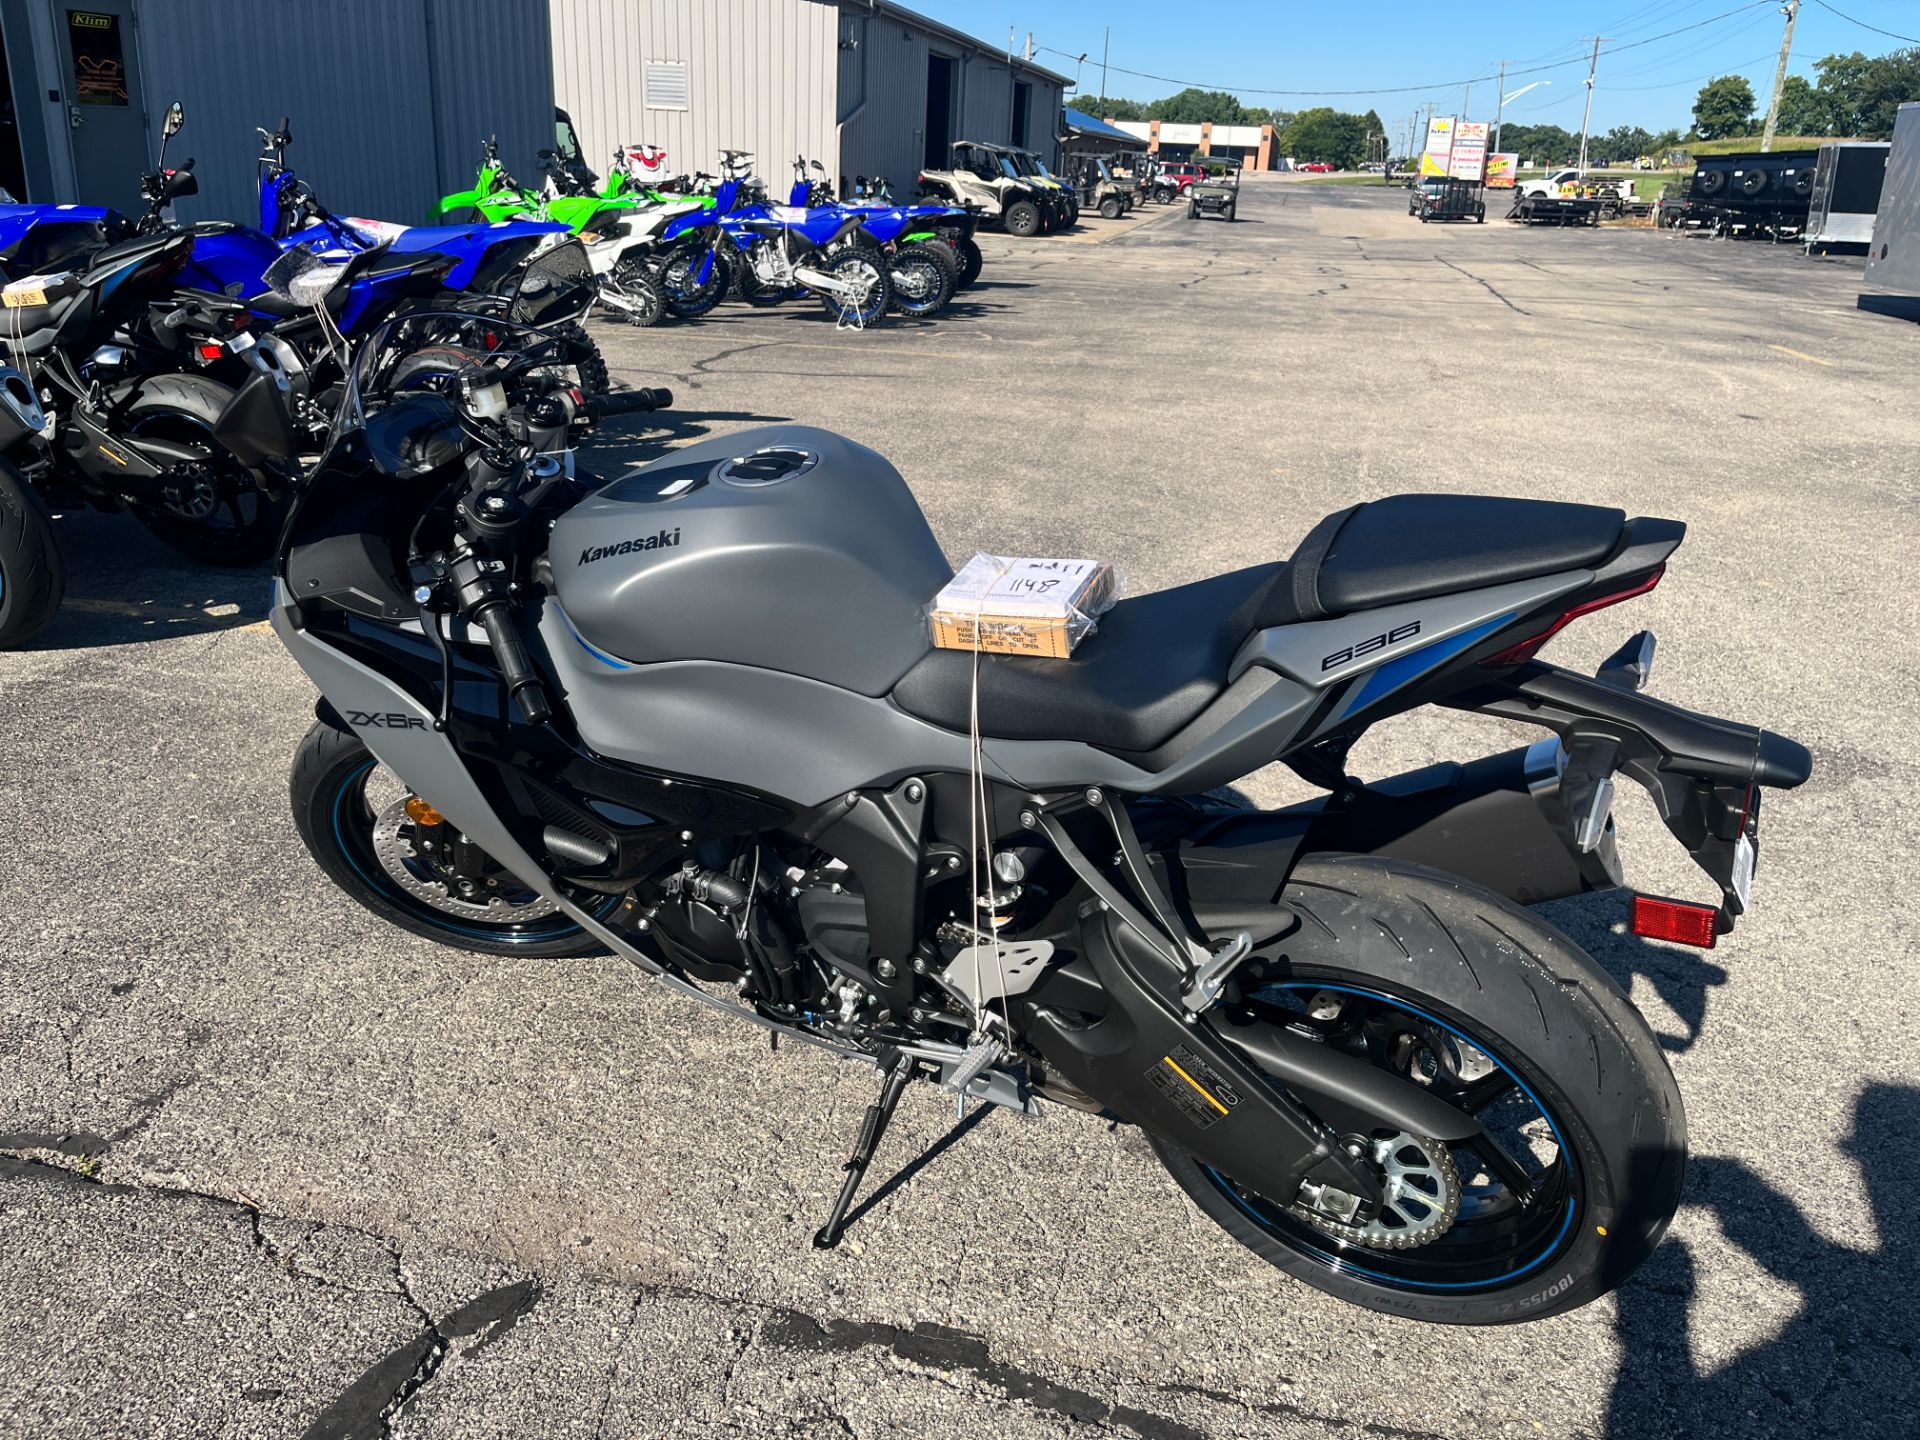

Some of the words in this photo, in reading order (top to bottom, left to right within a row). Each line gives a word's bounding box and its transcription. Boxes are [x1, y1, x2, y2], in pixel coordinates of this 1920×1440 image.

[577, 527, 681, 567] Kawasaki
[958, 637, 982, 645] DASHD
[1321, 620, 1421, 672] 636
[345, 710, 429, 731] ZX-6R
